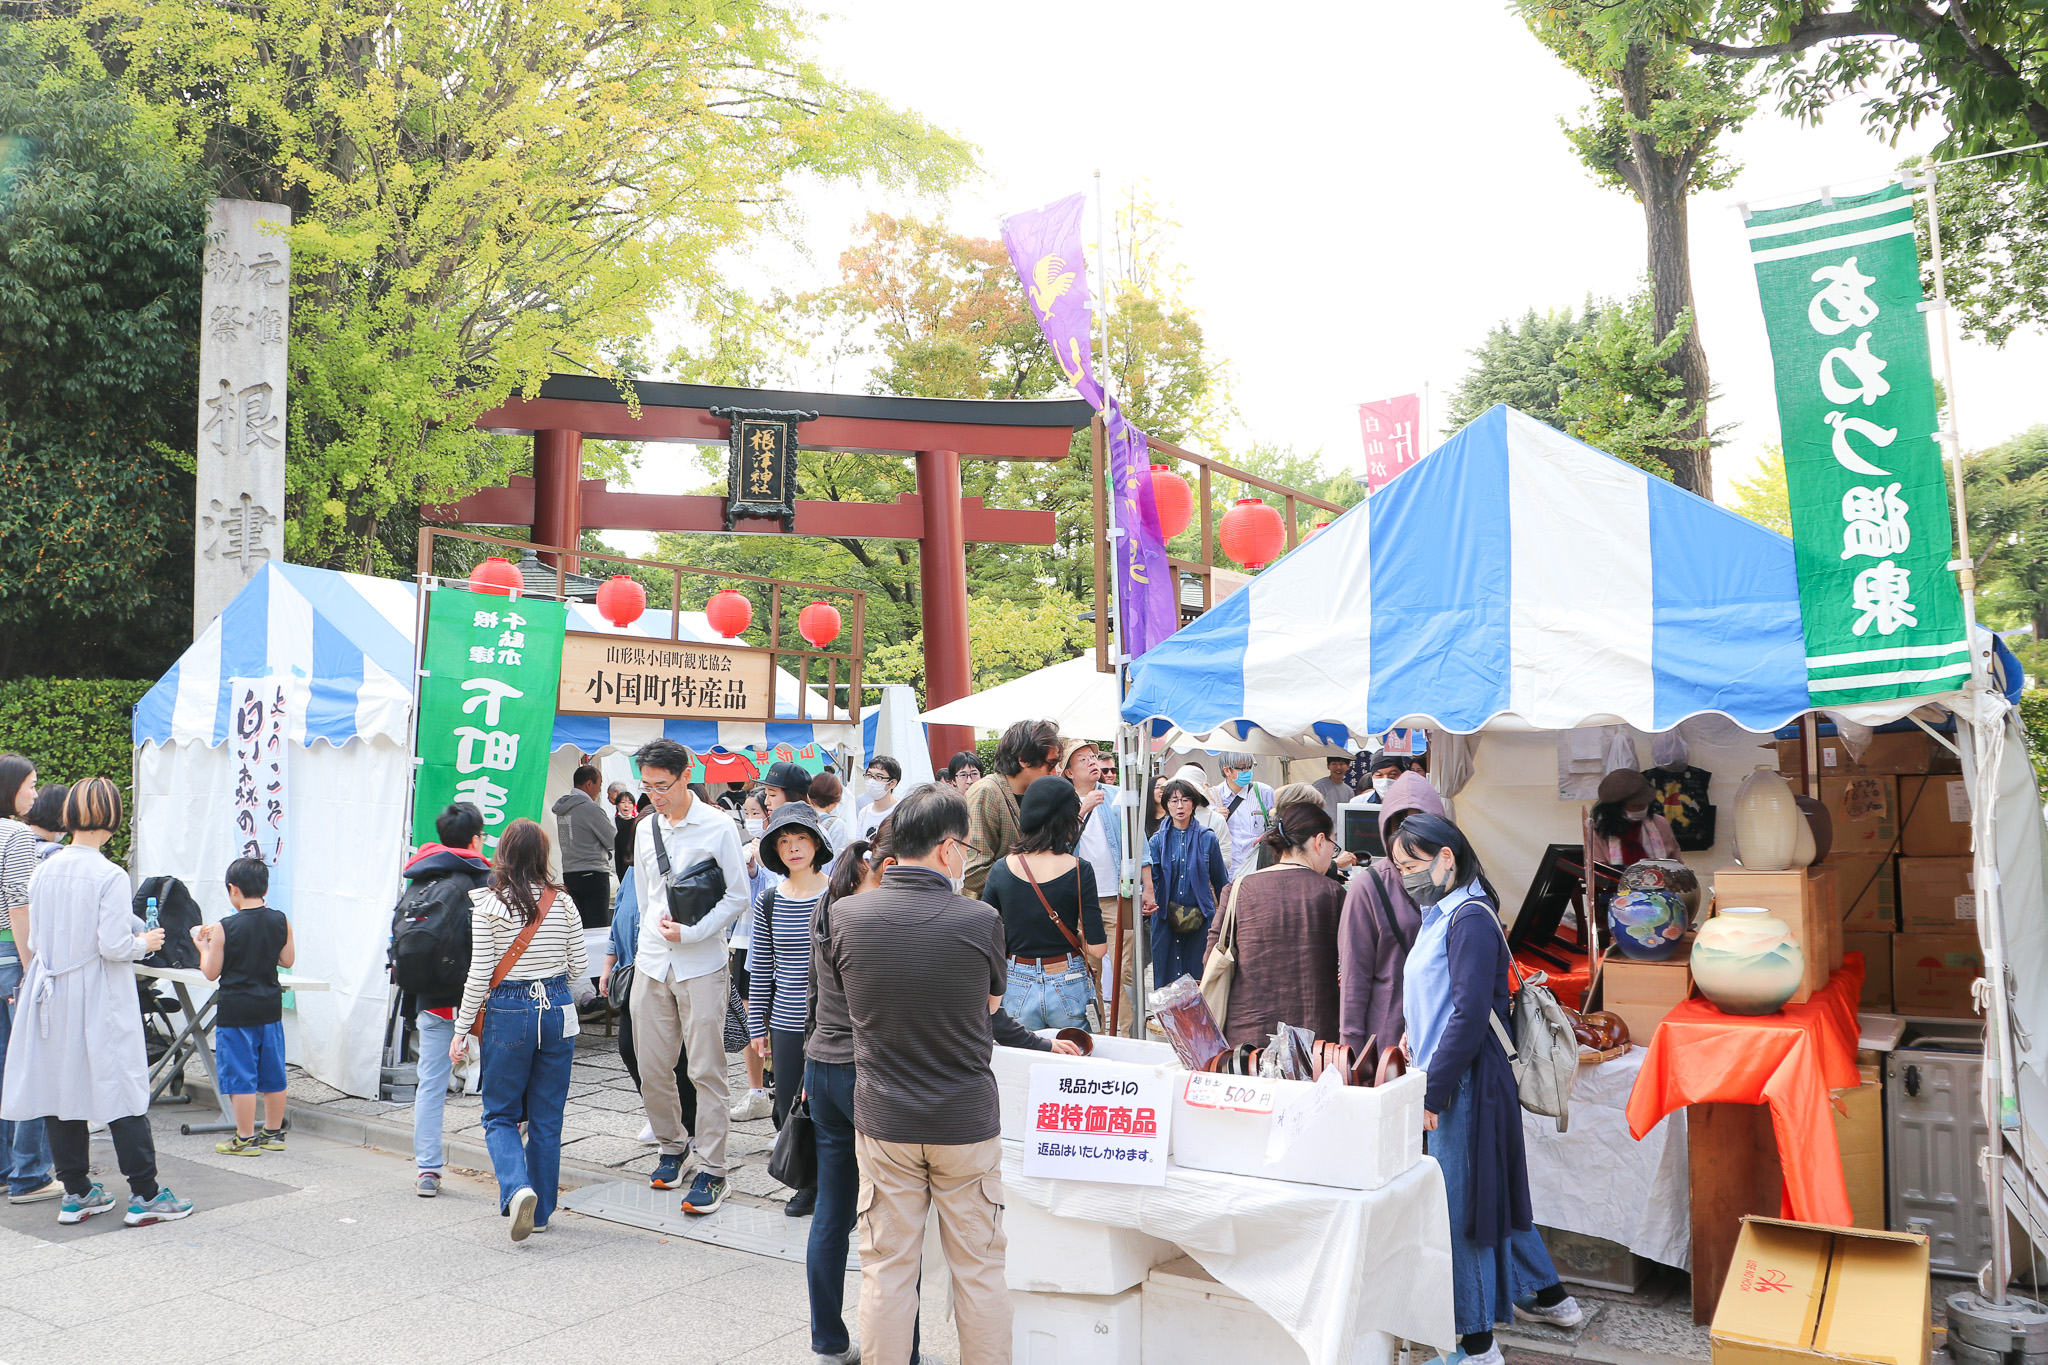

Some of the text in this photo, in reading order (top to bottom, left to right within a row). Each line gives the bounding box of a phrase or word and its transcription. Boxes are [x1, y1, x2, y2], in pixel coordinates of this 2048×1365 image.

[246, 251, 285, 346] 元准
[202, 378, 283, 574] 根津
[749, 428, 775, 495] 根津神社
[606, 645, 732, 672] 山形県小国町観光協会
[585, 670, 747, 710] 小国町特産品
[1059, 1078, 1139, 1096] 現品かぎりの
[1036, 1102, 1157, 1135] 超特価商品
[1037, 1142, 1153, 1163] 返品はいたしかねます。
[1744, 1270, 1754, 1279] NO
